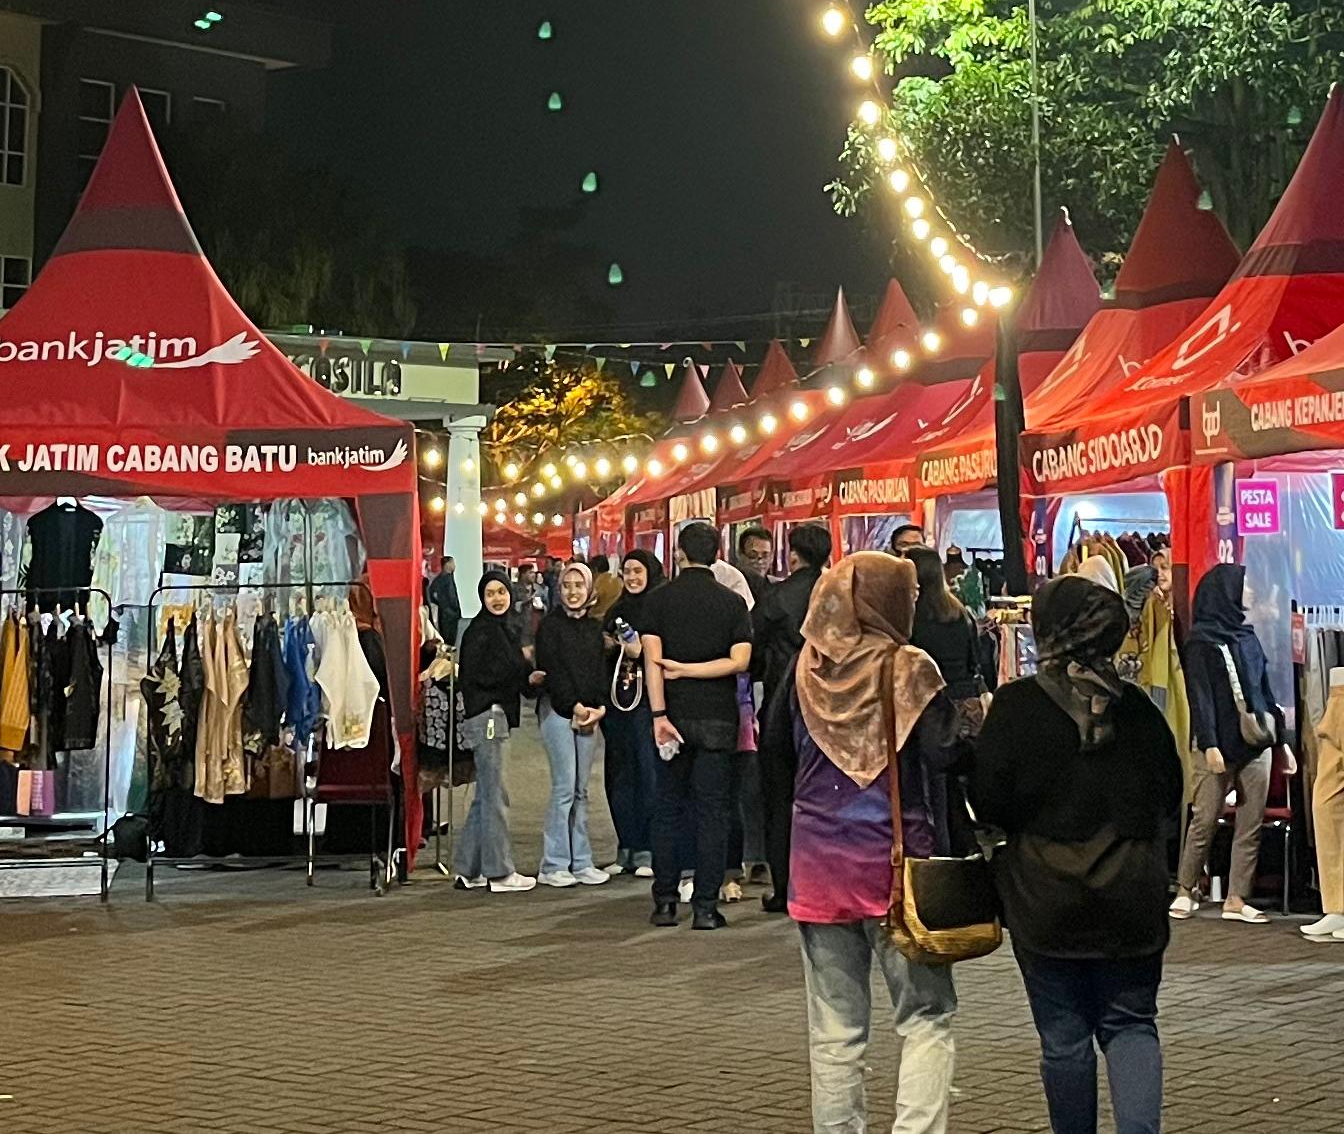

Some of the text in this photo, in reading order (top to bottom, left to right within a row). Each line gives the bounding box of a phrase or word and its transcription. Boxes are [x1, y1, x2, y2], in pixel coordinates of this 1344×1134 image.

[292, 353, 403, 396] ASILA
[1250, 399, 1293, 432] CABANG
[17, 443, 100, 472] JATIM
[105, 444, 220, 473] CABANG
[224, 444, 298, 473] BATU
[307, 445, 386, 469] bankjatim
[1031, 422, 1164, 483] CABANG SIDOARJO
[921, 448, 998, 488] CABANG PASURU
[1240, 489, 1275, 506] PESTA
[1245, 512, 1272, 528] SALE
[1218, 538, 1234, 564] 02
